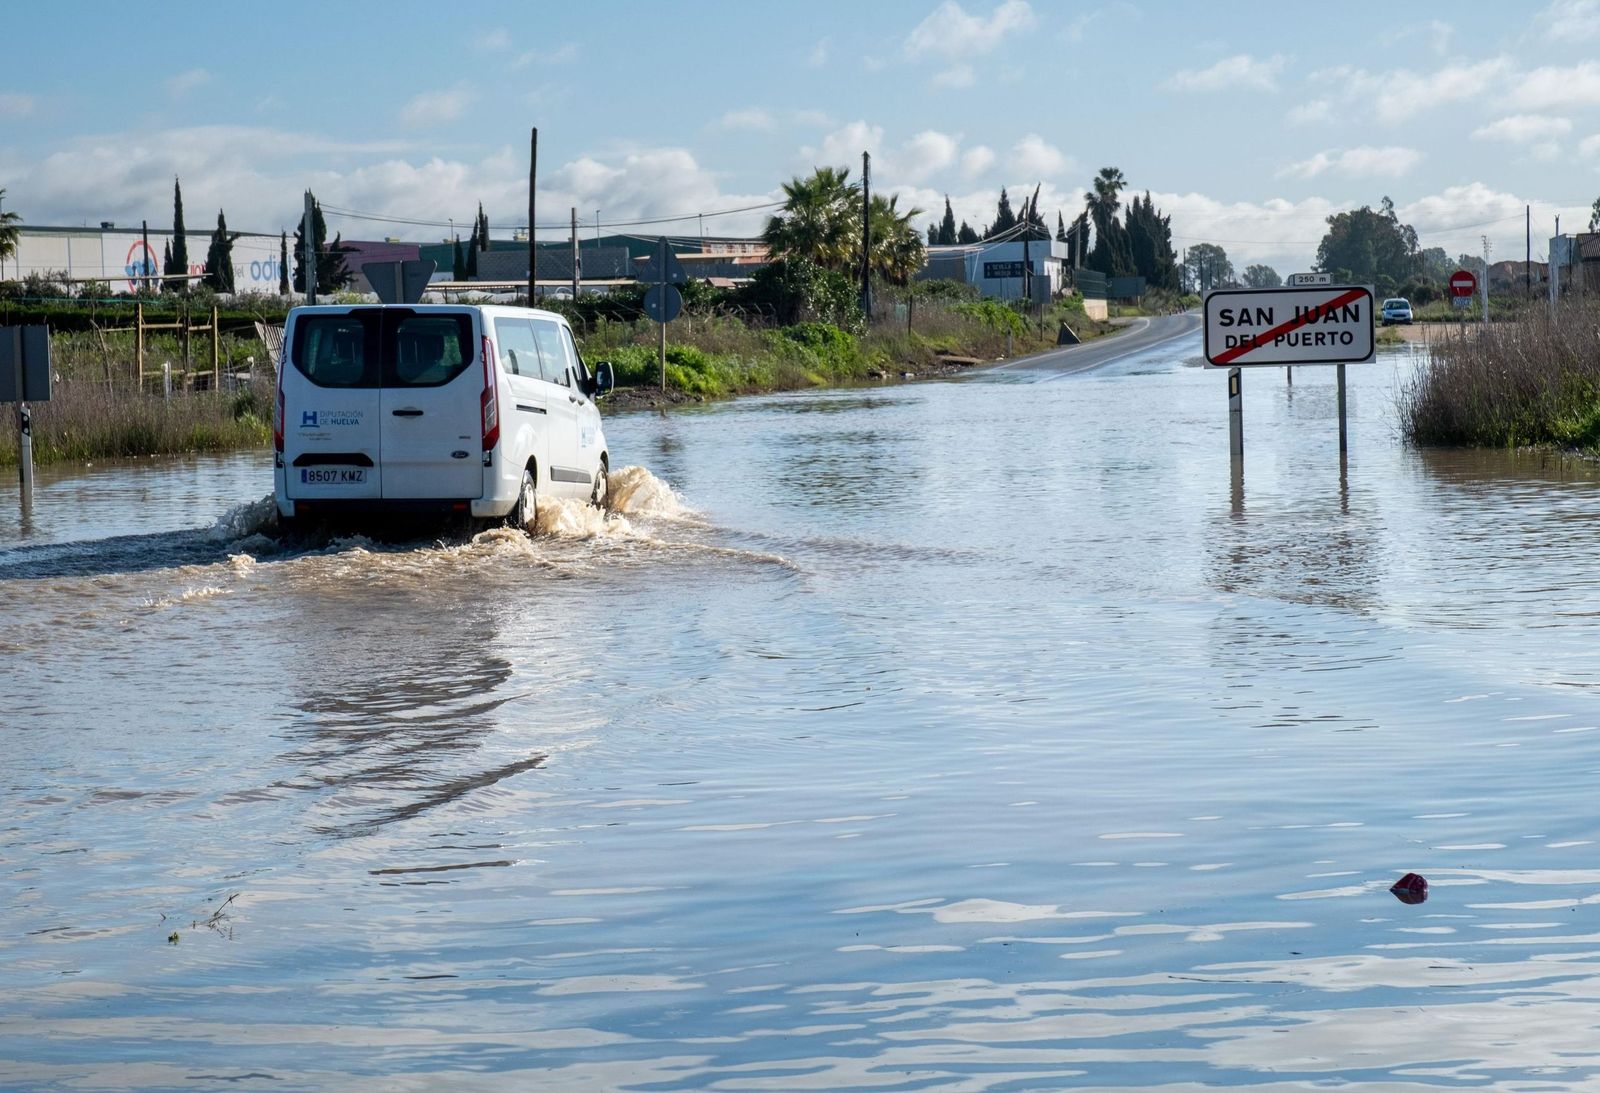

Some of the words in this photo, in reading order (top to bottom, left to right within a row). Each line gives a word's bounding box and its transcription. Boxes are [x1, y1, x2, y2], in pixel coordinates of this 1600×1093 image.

[1299, 275, 1314, 283] 250
[1219, 307, 1274, 327] SAN
[1290, 304, 1360, 325] JUAN
[1225, 334, 1262, 349] DEL
[1274, 331, 1354, 348] PUERTO
[320, 410, 363, 418] DIPUTACIÓN
[309, 470, 337, 482] 8507
[341, 470, 363, 482] KMZ
